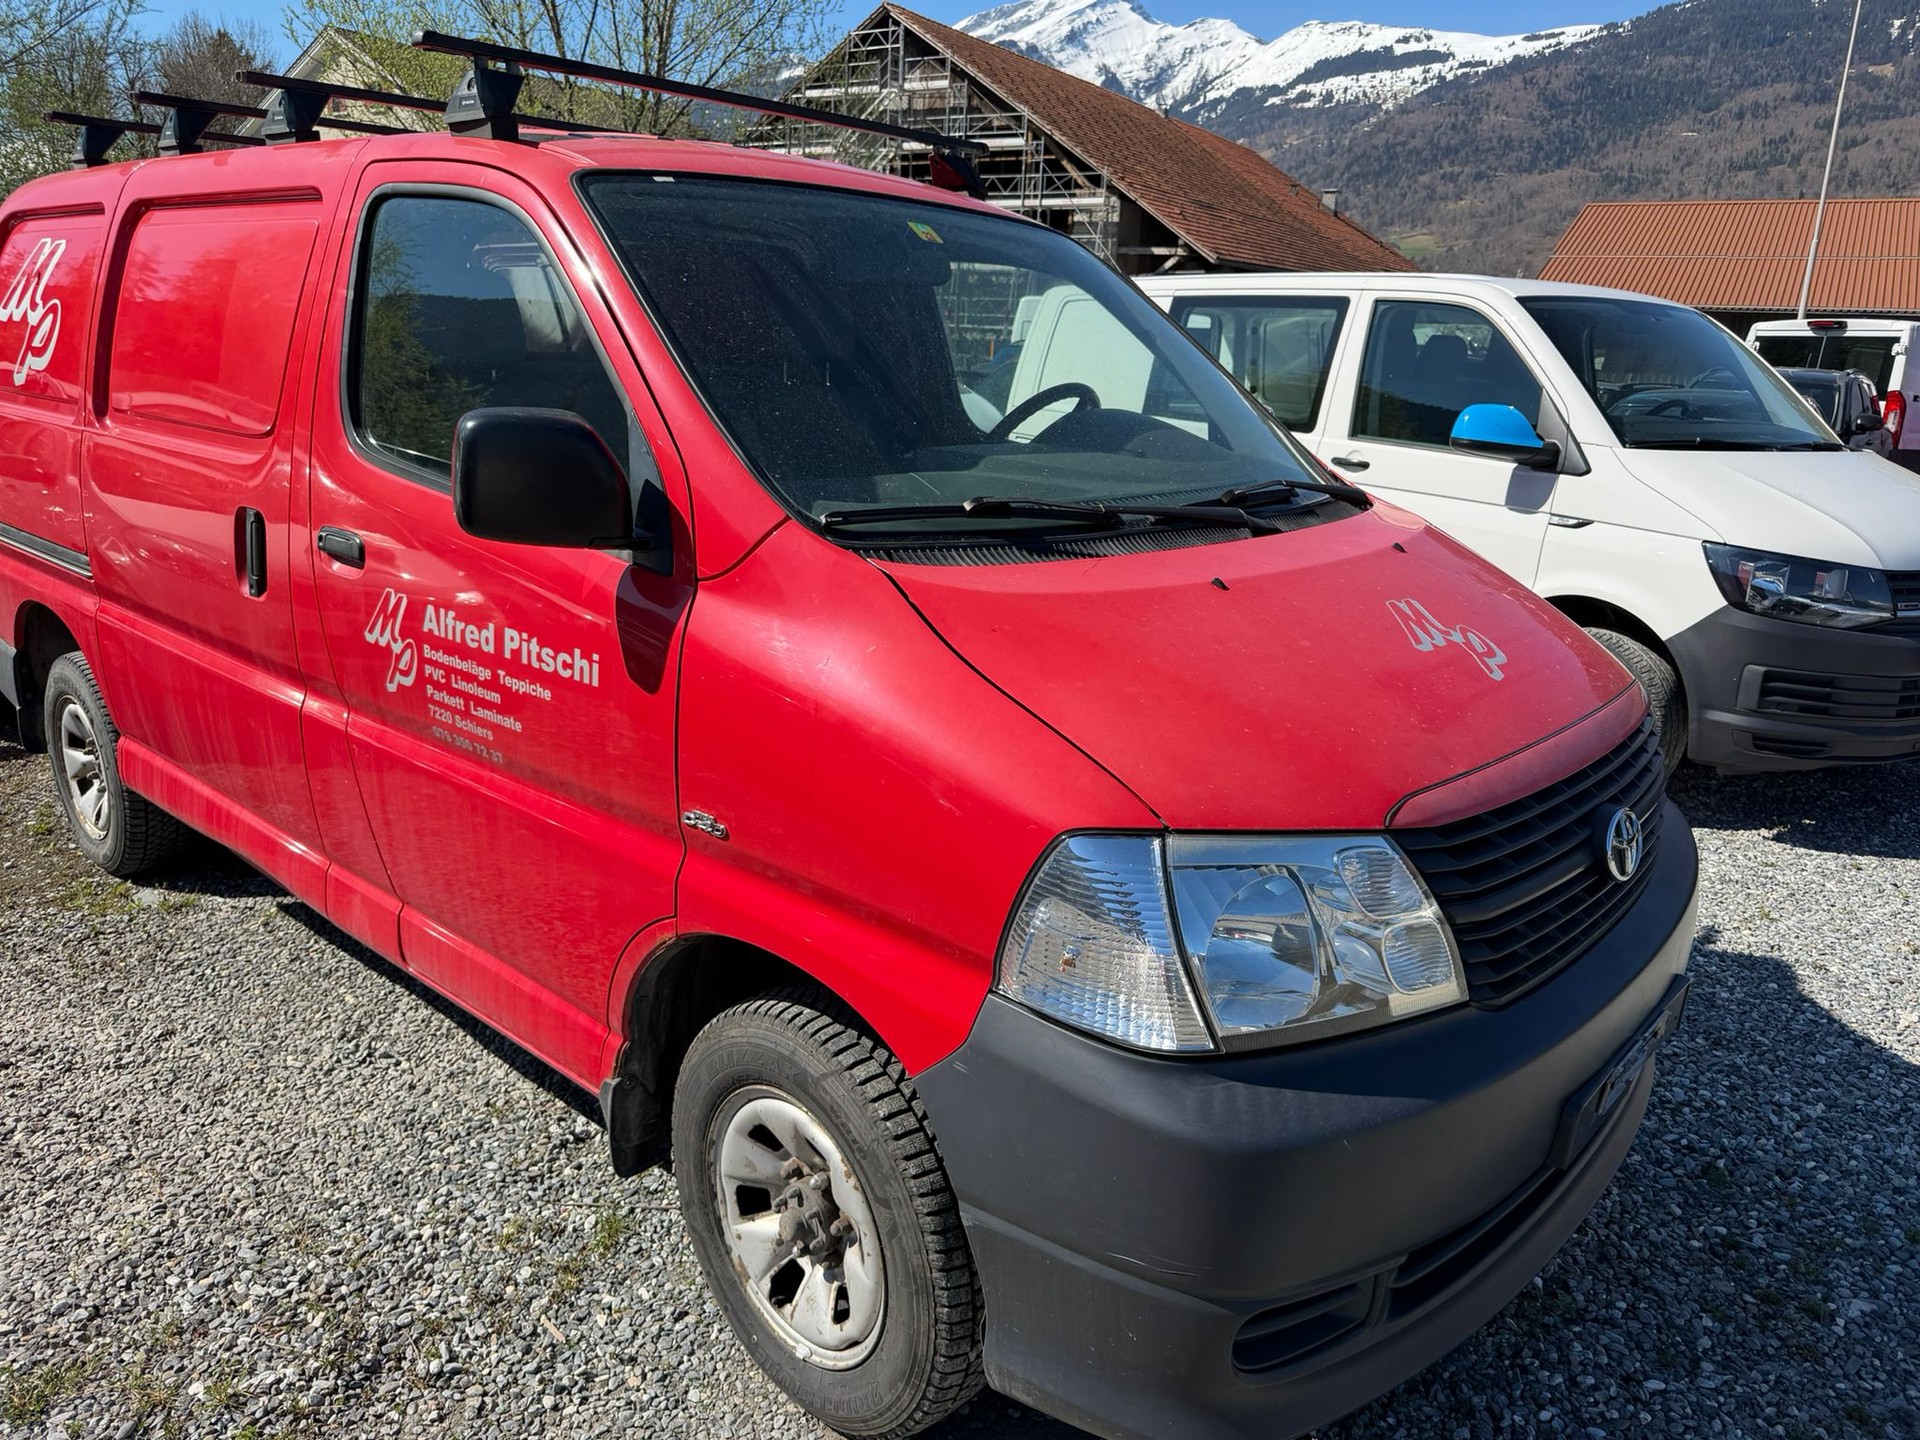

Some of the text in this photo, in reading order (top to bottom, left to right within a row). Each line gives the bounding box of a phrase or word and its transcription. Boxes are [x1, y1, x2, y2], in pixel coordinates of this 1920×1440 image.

[422, 604, 599, 687] Alfred Pitschi
[423, 643, 552, 701] Bodenbeläge Teppiche
[425, 664, 501, 704] PVC Linoleum
[426, 685, 522, 733] Parkett Laminate
[428, 704, 494, 741] 7220 Schiers
